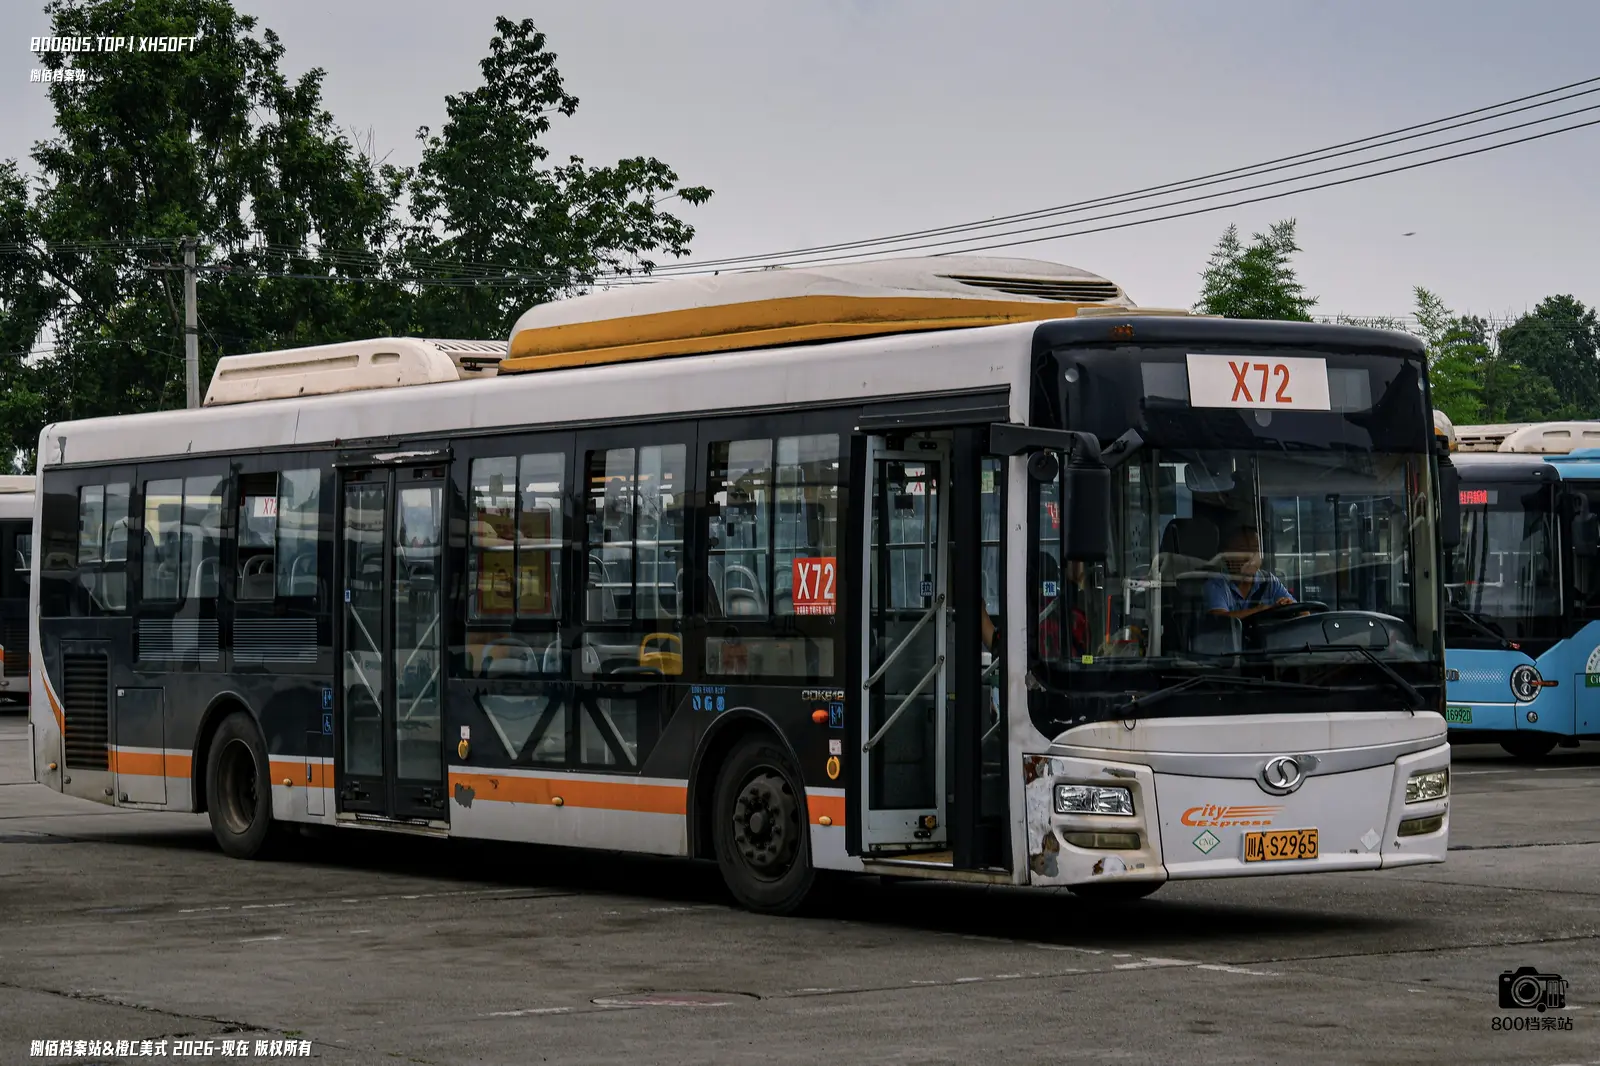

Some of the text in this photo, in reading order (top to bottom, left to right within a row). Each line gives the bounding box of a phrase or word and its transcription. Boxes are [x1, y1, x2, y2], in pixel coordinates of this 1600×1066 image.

[1228, 361, 1292, 403] X72
[798, 563, 834, 600] X72
[1181, 804, 1226, 827] City
[1196, 819, 1272, 828] Express
[1199, 838, 1214, 846] CNG
